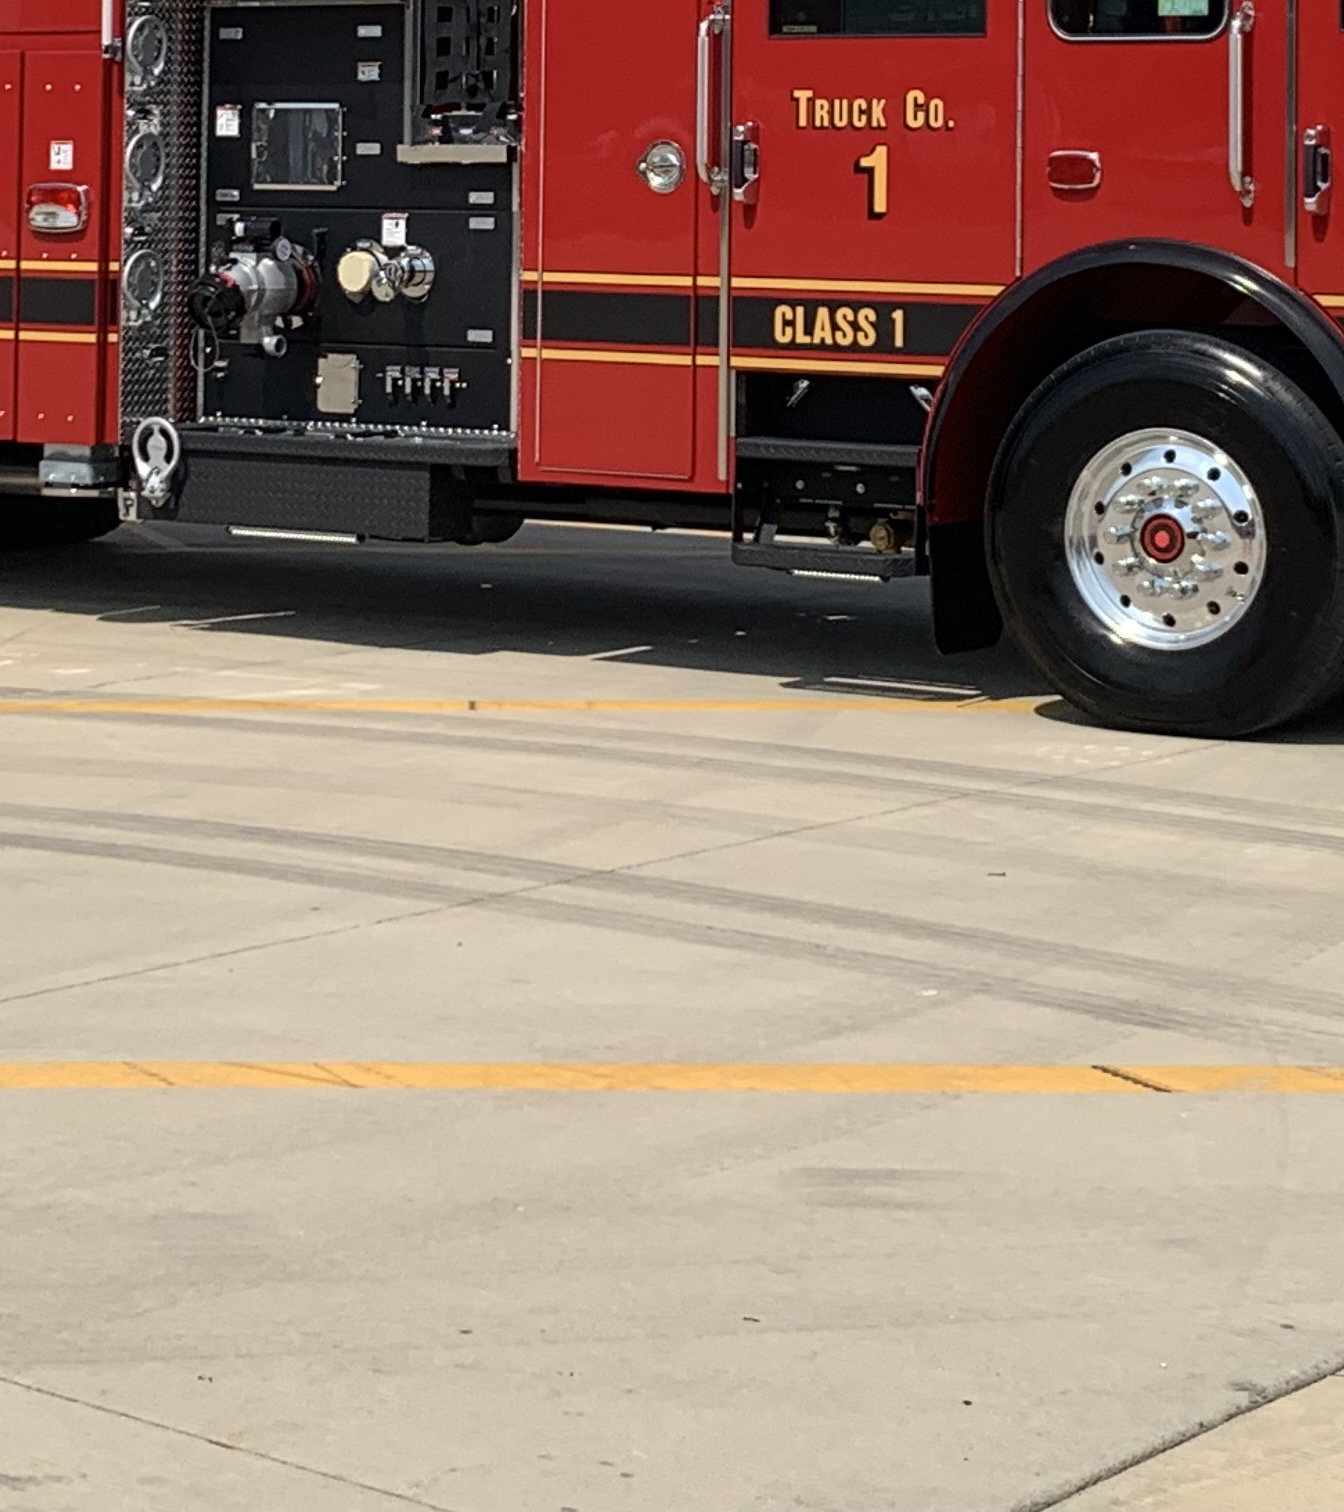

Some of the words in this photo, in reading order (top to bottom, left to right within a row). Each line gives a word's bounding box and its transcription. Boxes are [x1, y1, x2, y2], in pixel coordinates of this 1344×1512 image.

[792, 89, 887, 129] TRUCK
[904, 89, 955, 130] CO.
[855, 144, 889, 218] 1
[773, 304, 877, 348] CLASS
[891, 309, 904, 348] 1
